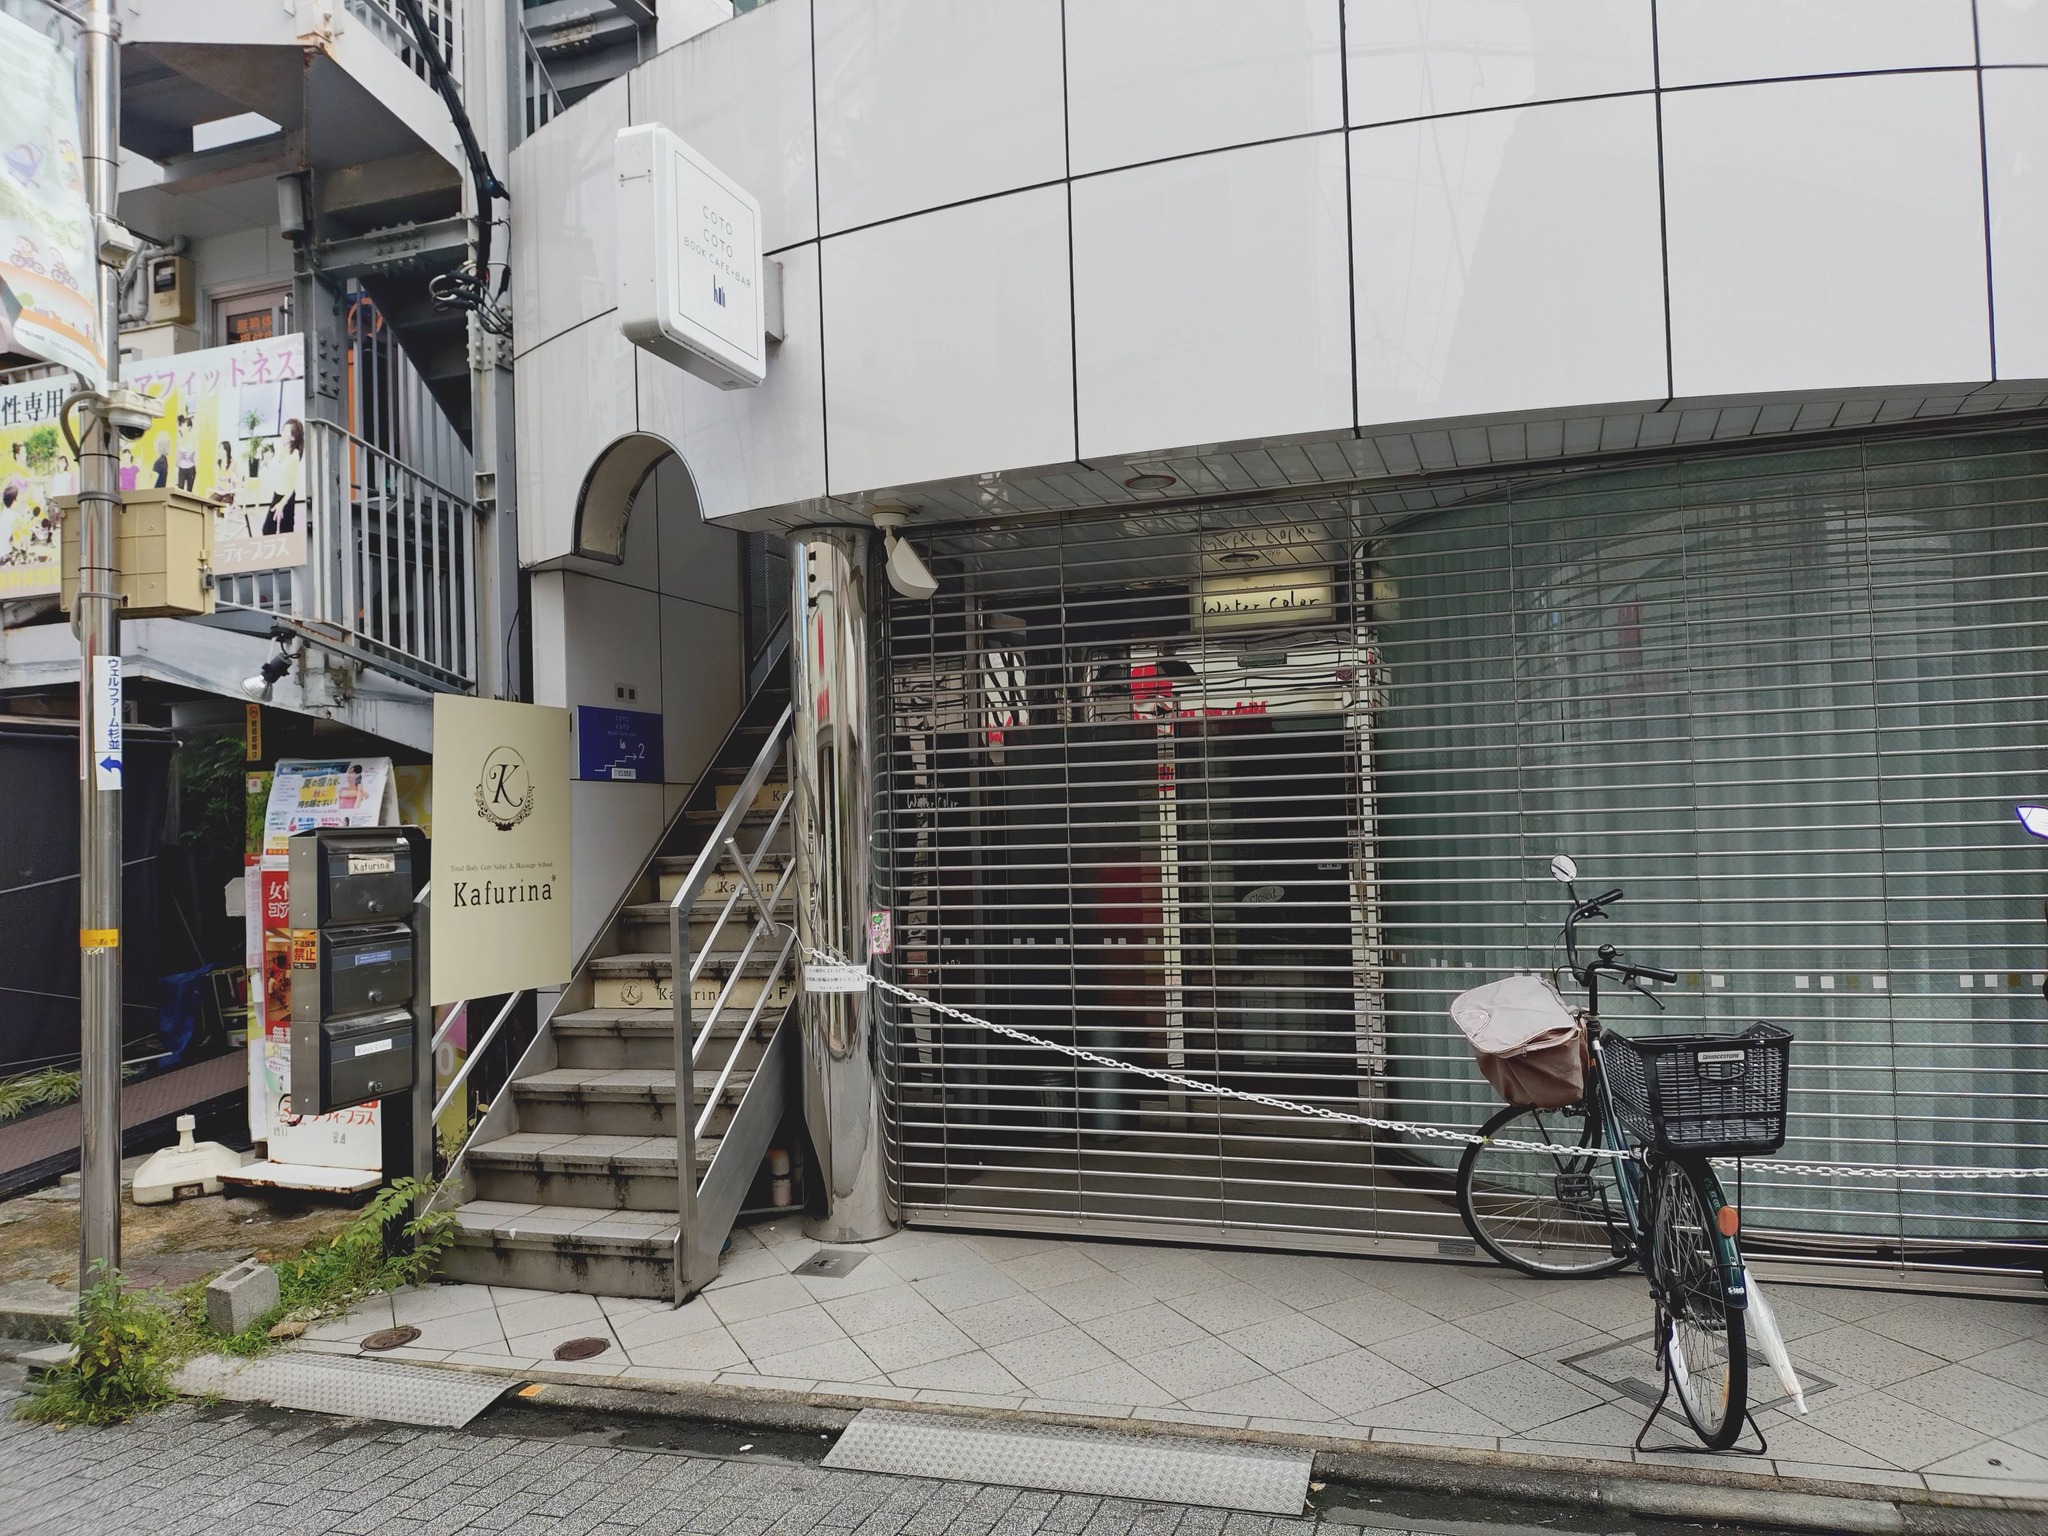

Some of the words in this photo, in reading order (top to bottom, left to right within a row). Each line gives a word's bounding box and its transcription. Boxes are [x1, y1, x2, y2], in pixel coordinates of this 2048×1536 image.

[702, 205, 733, 236] COTO
[683, 235, 706, 259] BOOK
[703, 228, 734, 258] COTO
[1203, 598, 1260, 613] Water
[1269, 590, 1320, 609] Color
[107, 657, 121, 751] ウェルファーム杉並
[638, 743, 645, 759] 2
[486, 763, 525, 808] K
[353, 862, 390, 872] Kafurina
[466, 864, 479, 872] Body
[293, 947, 316, 961] 禁止
